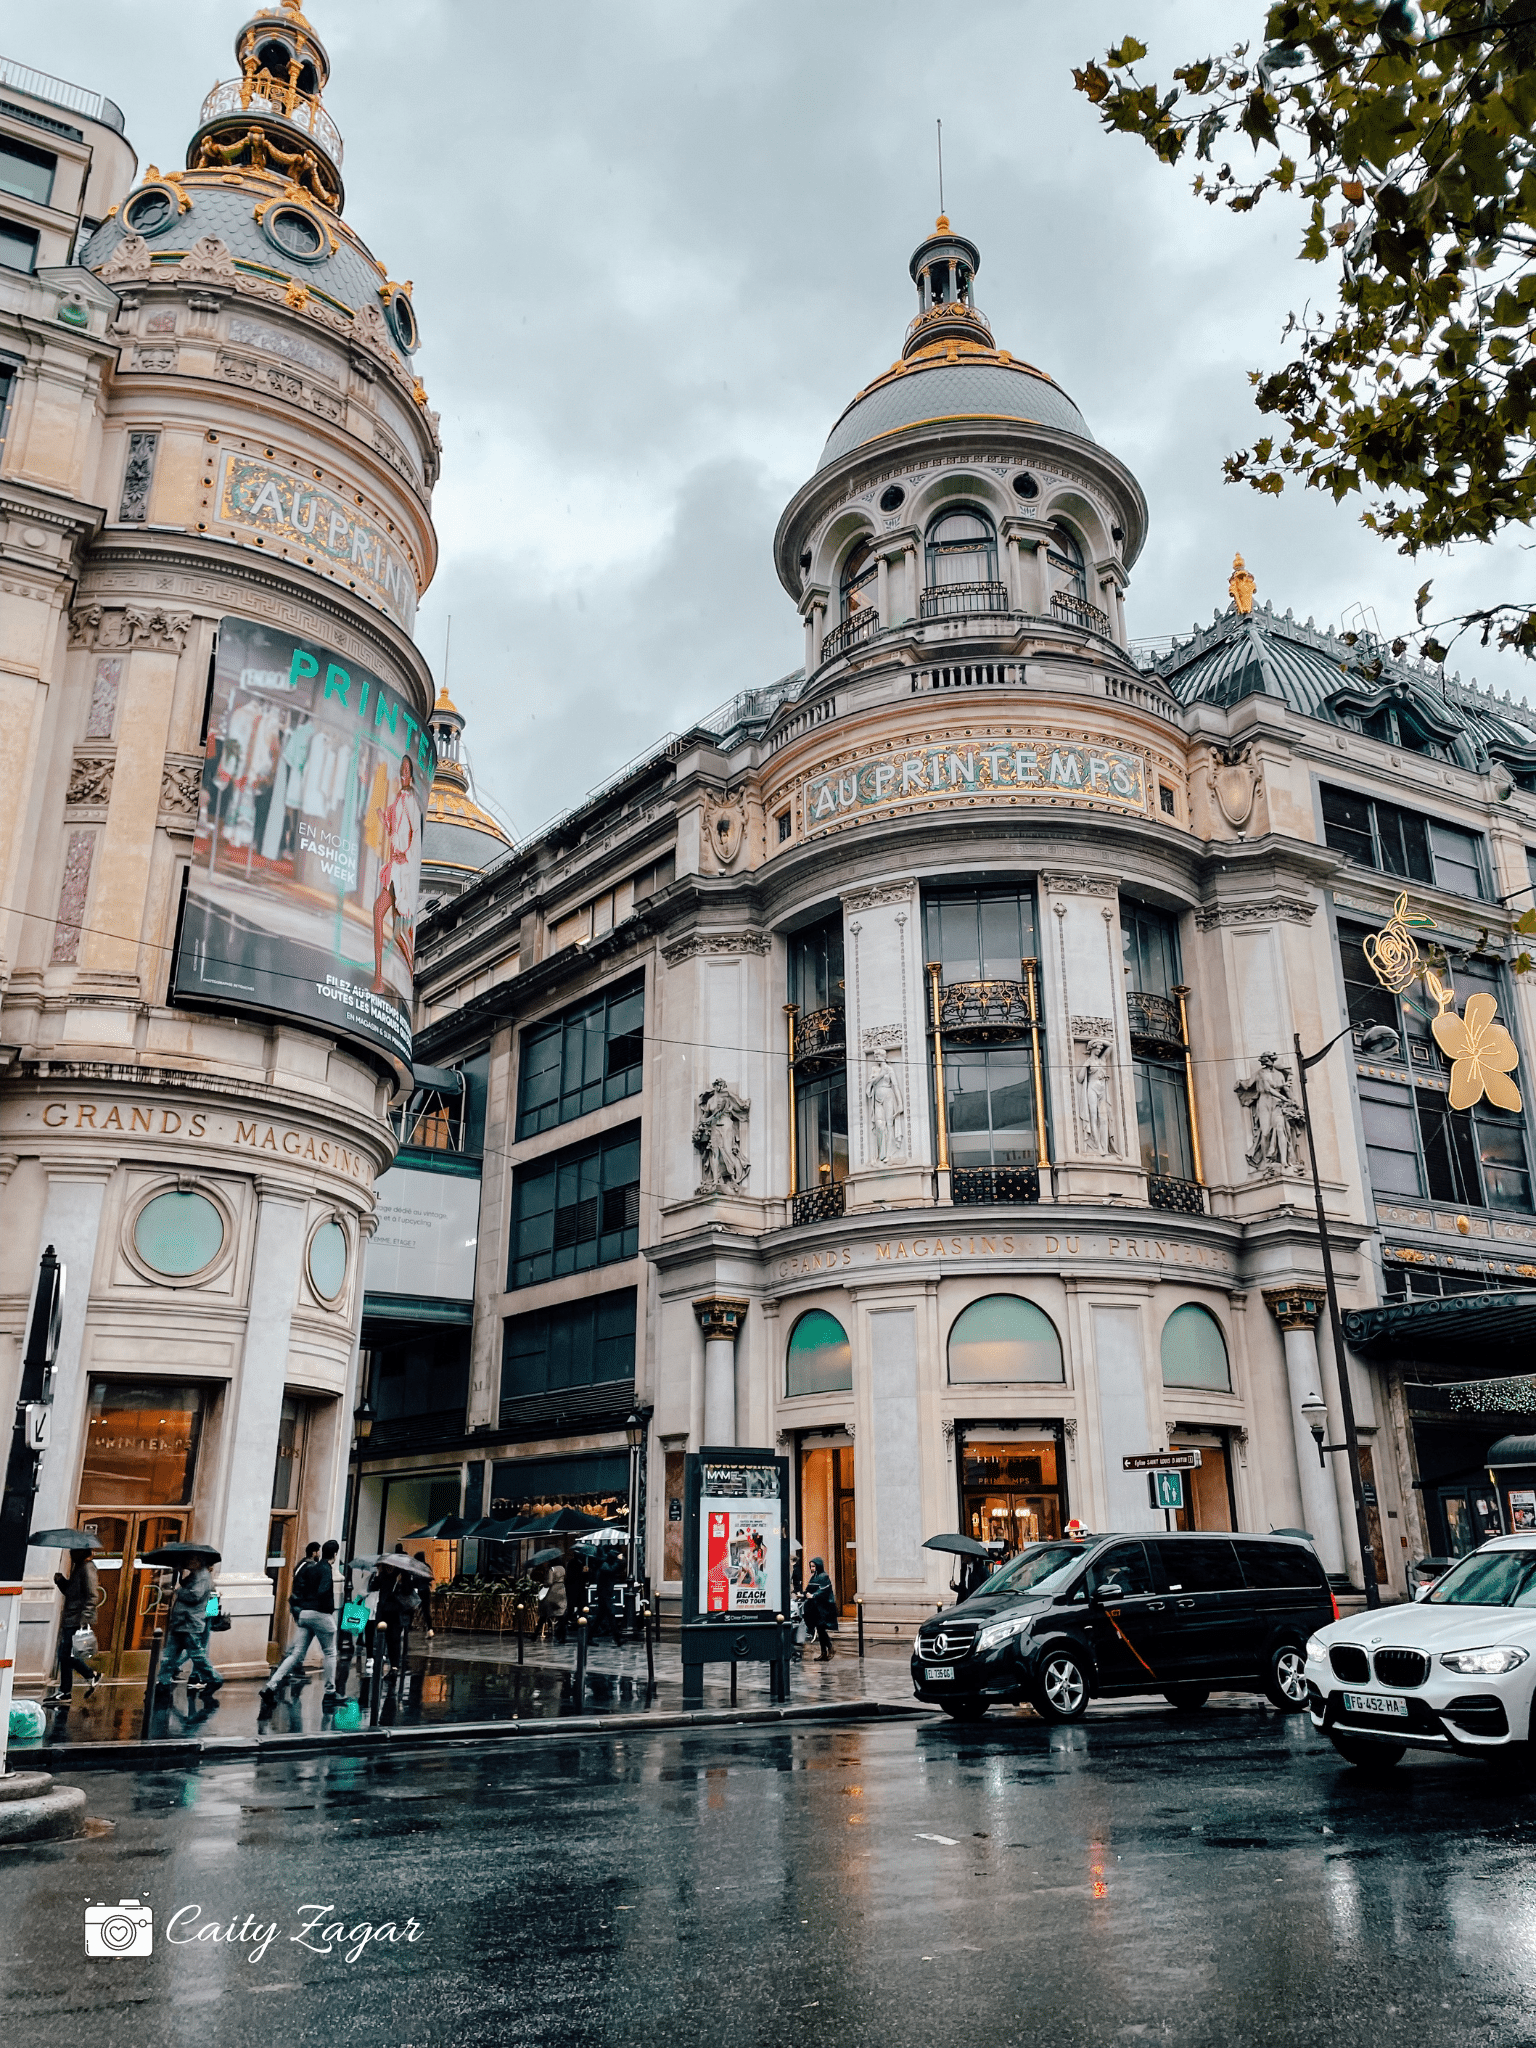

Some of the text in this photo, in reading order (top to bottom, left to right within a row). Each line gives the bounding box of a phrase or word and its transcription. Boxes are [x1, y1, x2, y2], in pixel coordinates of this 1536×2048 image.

[250, 481, 317, 534] AU
[815, 750, 1131, 819] AU PRINTEMPS
[299, 822, 358, 855] EN MODE
[300, 838, 356, 870] FASHION
[321, 860, 355, 884] WEEK
[316, 984, 353, 1007] TOUTES
[356, 998, 370, 1014] LES
[371, 1006, 400, 1034] MARQUES
[346, 1012, 355, 1021] EN
[42, 1103, 207, 1138] GRANDS
[233, 1120, 360, 1178] MAGASINS
[376, 1205, 392, 1213] tage
[393, 1206, 412, 1215] dédié
[779, 1236, 1230, 1278] GRANDS MAGASINS DU PRINTEMPS
[736, 1591, 767, 1599] BEACH
